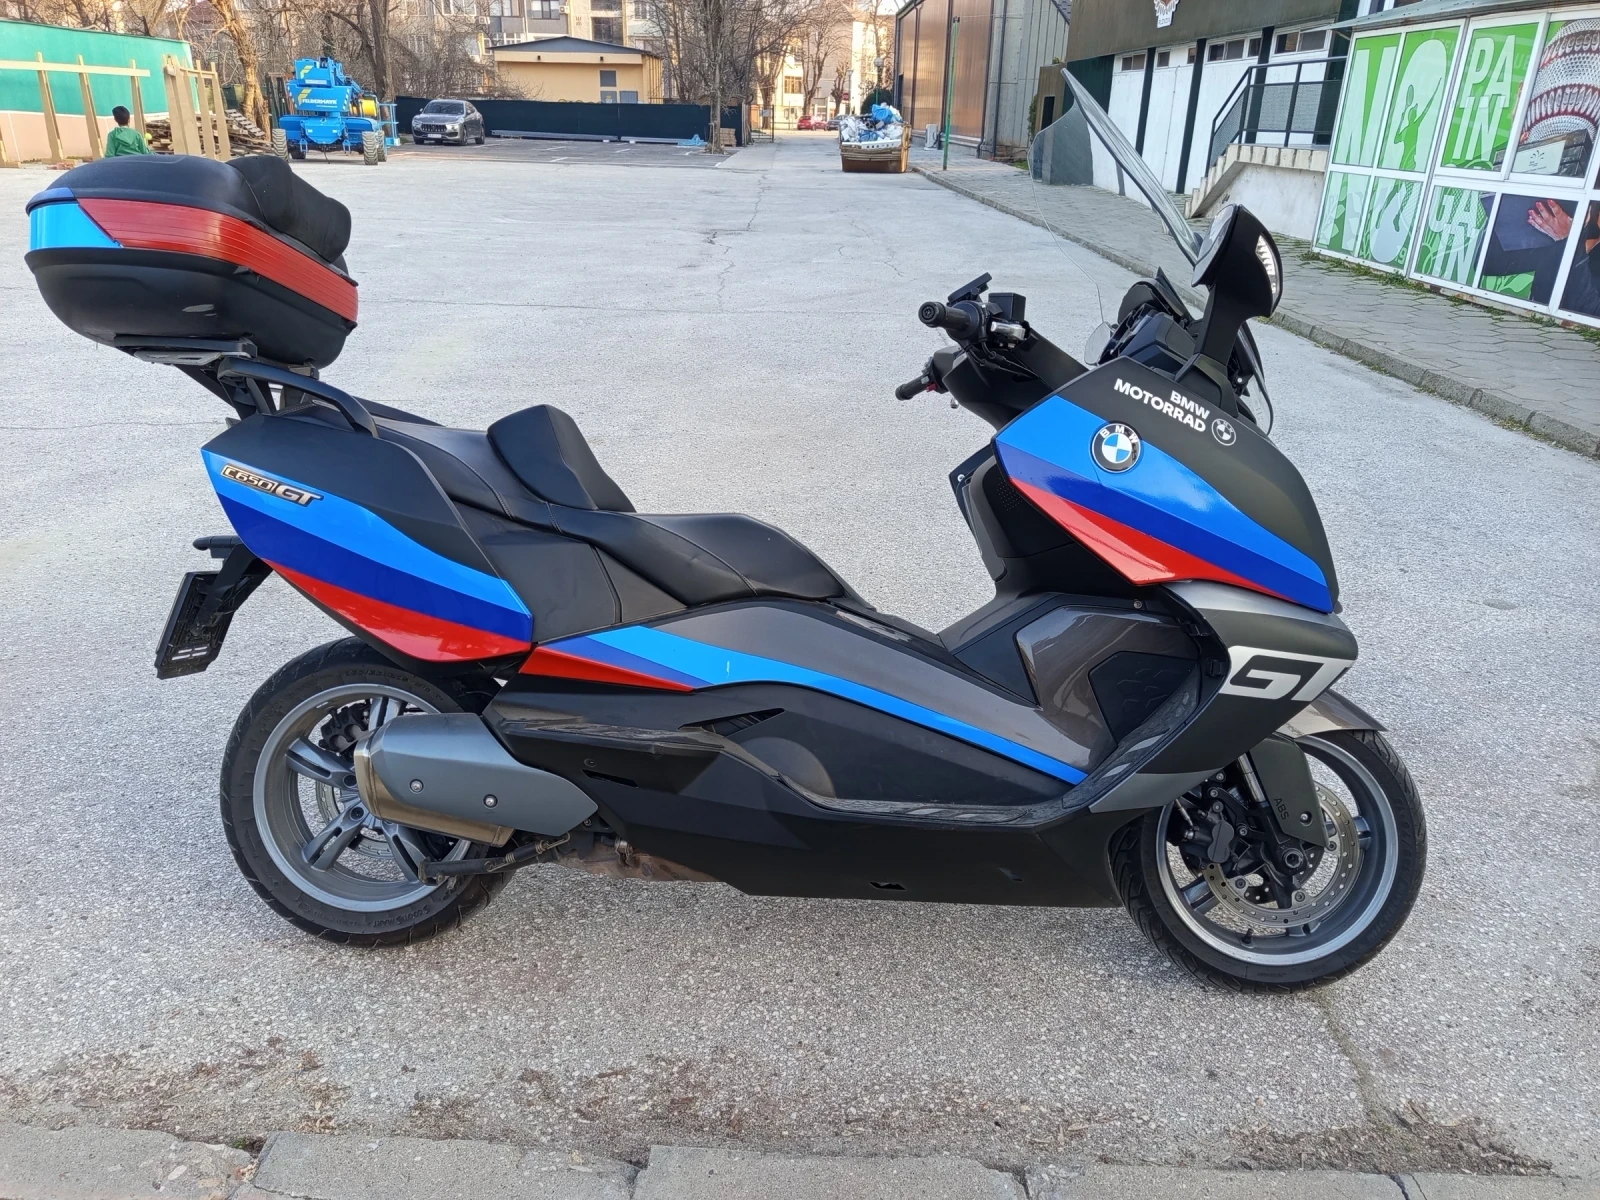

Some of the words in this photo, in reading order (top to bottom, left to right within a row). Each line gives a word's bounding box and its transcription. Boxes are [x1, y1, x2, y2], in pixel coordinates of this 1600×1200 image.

[1113, 378, 1206, 432] MOTORRAD
[1170, 390, 1210, 420] BMW
[1099, 425, 1139, 444] BMW
[275, 484, 322, 505] GT
[1274, 798, 1289, 820] ABS
